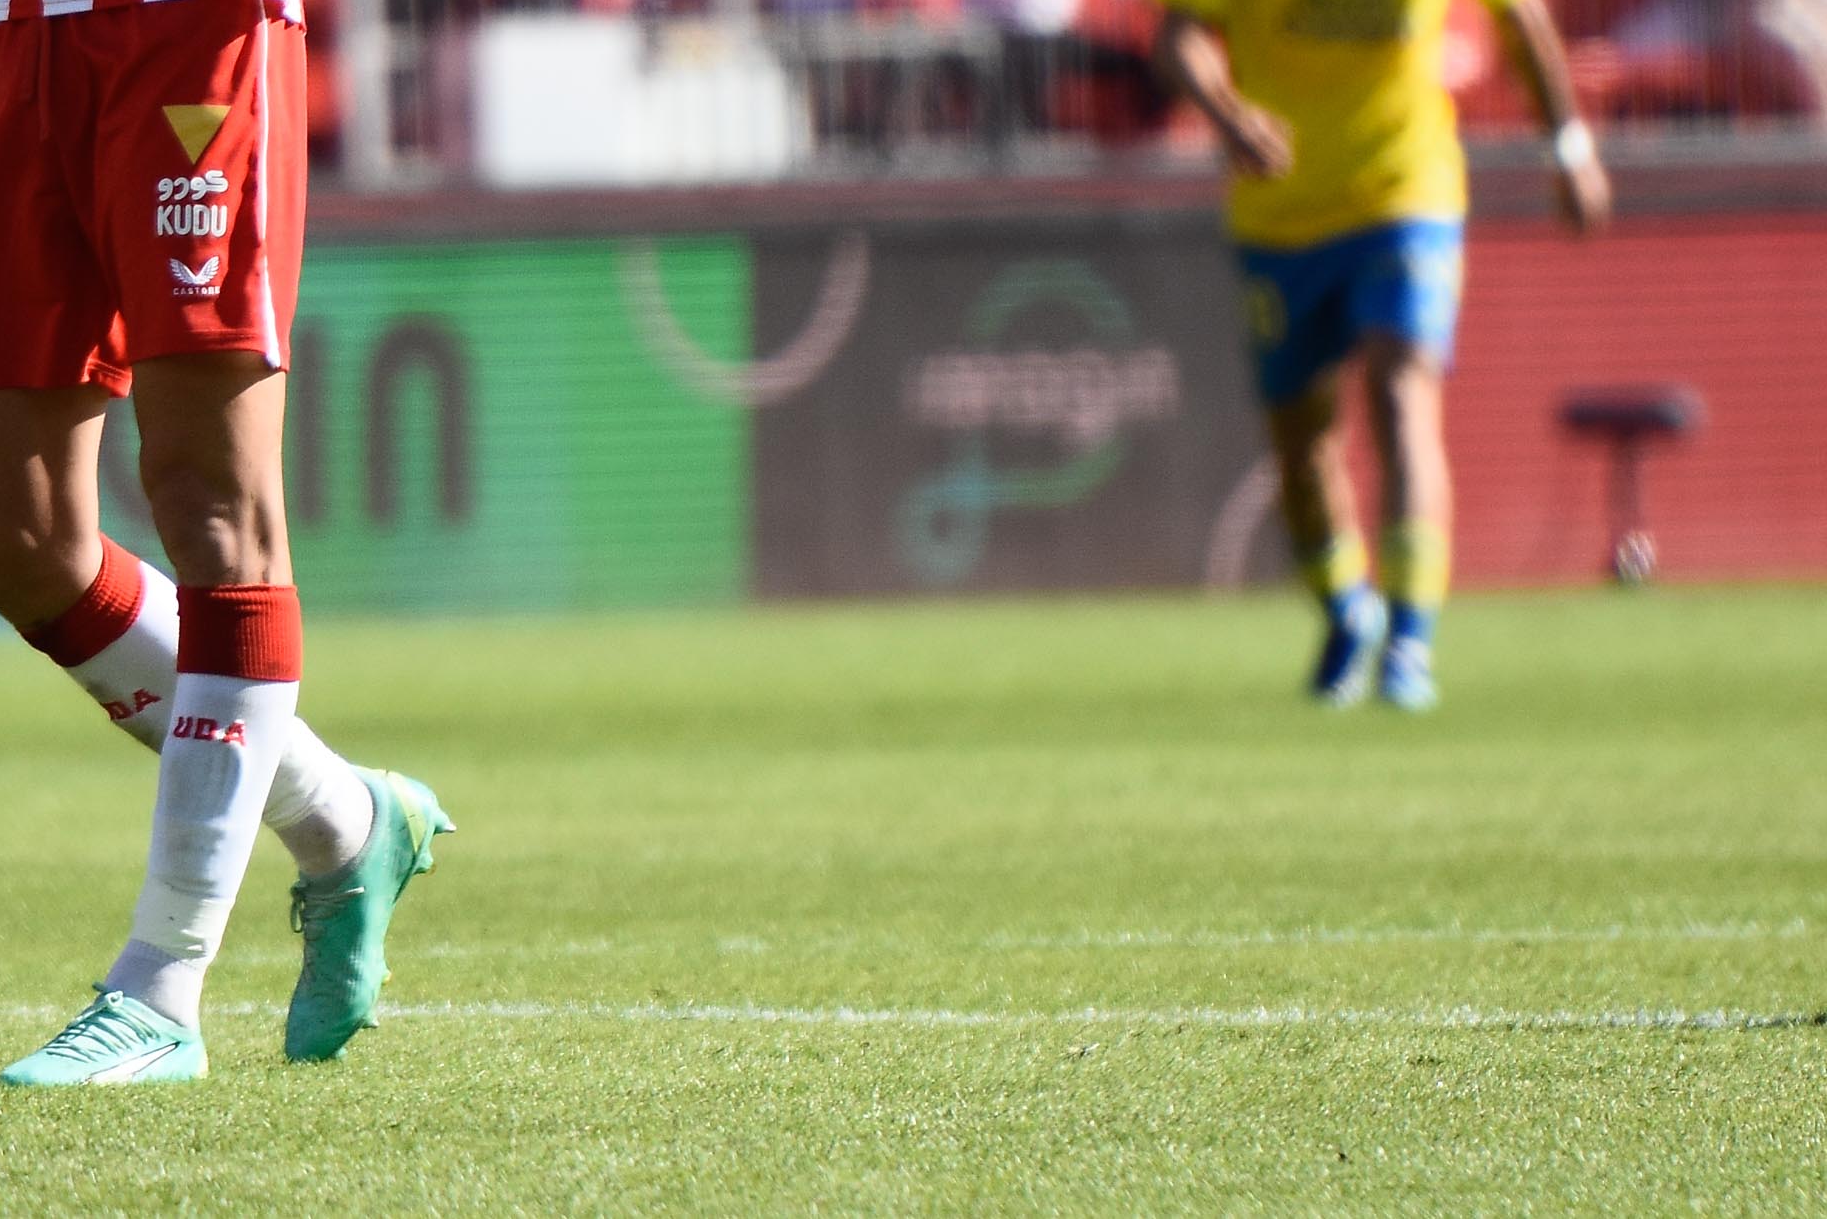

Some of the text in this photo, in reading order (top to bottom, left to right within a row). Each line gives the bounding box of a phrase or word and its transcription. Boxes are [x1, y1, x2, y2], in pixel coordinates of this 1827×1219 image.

[158, 170, 228, 201] كودو
[157, 204, 228, 237] KUDU
[173, 286, 221, 295] CASTORE
[174, 716, 246, 746] UDA
